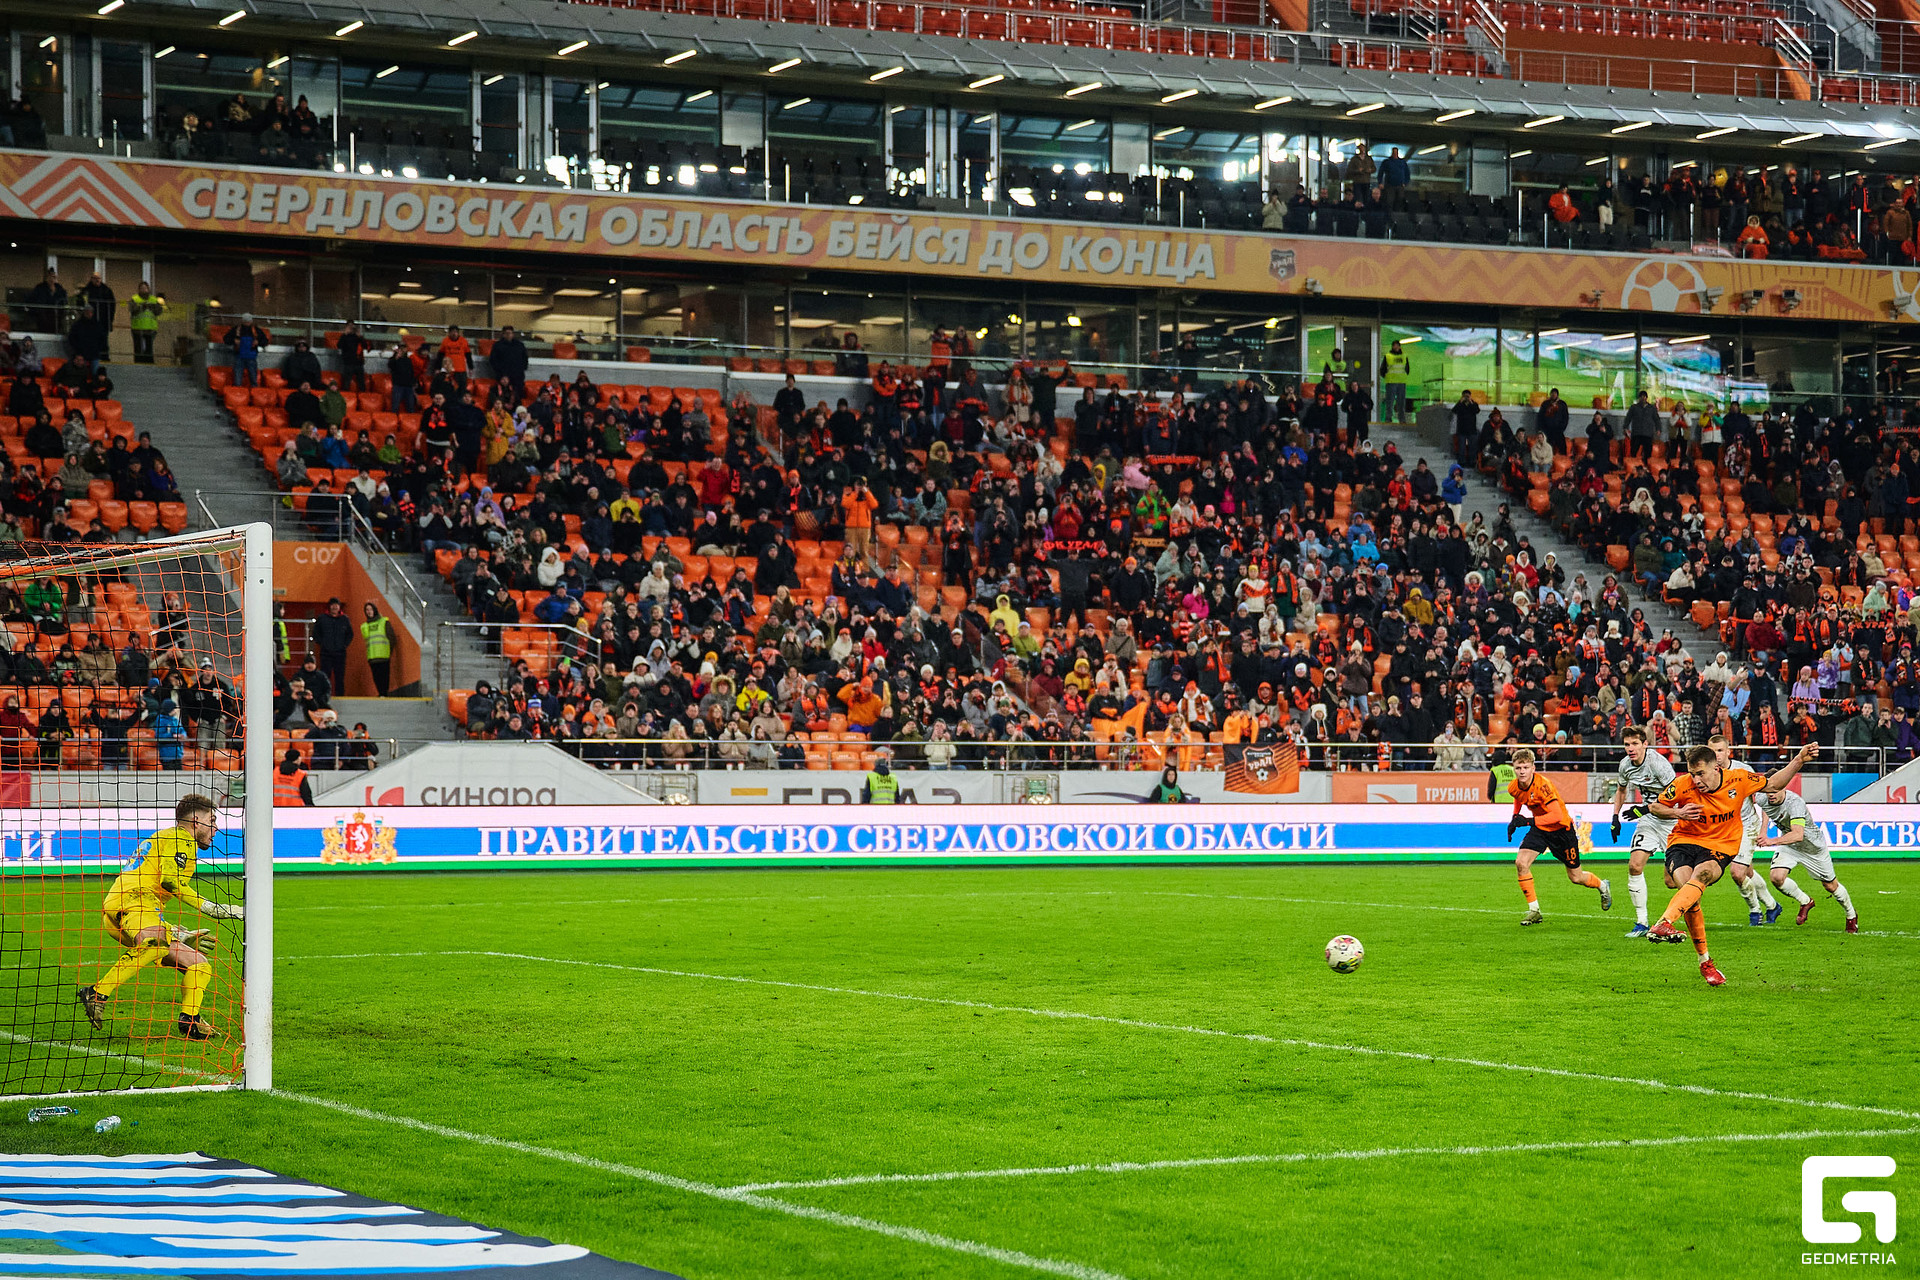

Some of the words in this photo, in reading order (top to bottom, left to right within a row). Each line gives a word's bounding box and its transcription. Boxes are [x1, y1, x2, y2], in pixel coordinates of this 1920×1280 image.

[182, 178, 589, 242] СВЕРДЛОВСКАЯ
[600, 206, 814, 255] ОБЛАСТЬ
[826, 215, 970, 265] БЕЙСЯ
[978, 230, 1049, 274] ДО
[1059, 235, 1216, 284] КОНЦА
[1424, 787, 1480, 802] ТРУБНАЯ
[477, 825, 837, 856] ПРАВИТЕЛЬСТВО
[1165, 823, 1337, 850] ОБЛАСТИ
[1632, 834, 1644, 848] 12
[1564, 848, 1577, 861] 18
